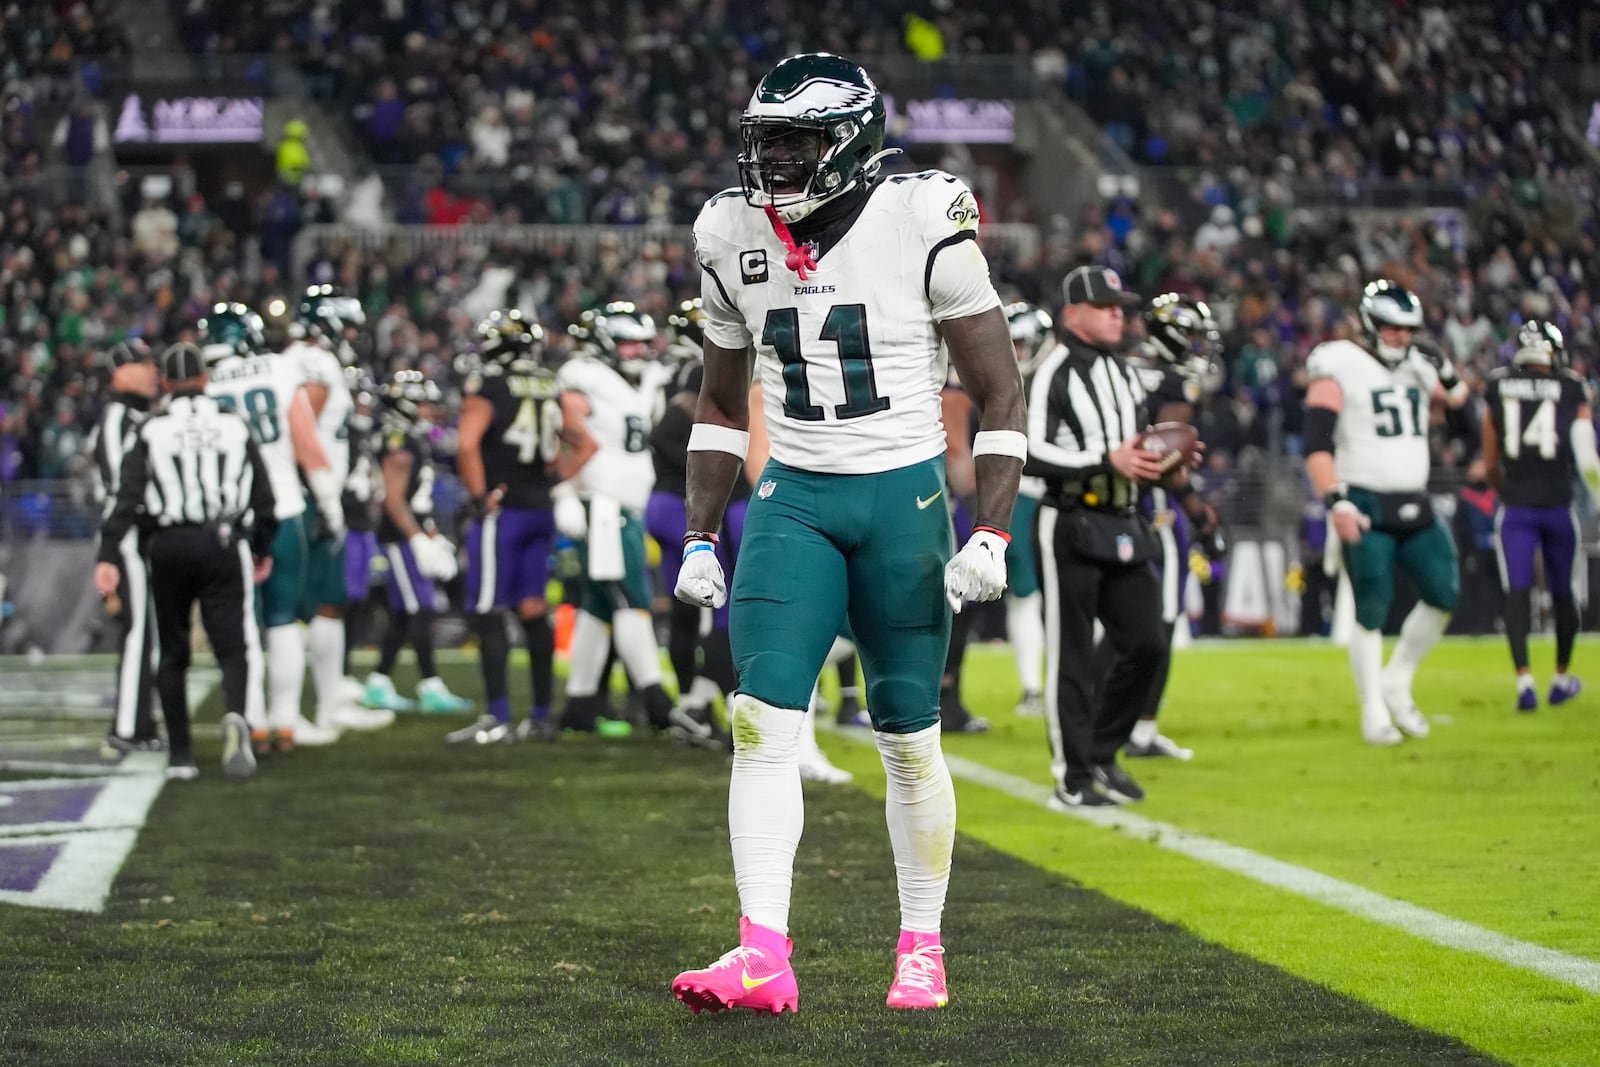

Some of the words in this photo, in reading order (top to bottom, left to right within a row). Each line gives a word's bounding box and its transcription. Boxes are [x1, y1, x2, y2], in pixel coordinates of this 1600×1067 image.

[742, 251, 766, 276] C
[794, 285, 836, 295] EAGLES
[762, 303, 891, 421] 11
[503, 398, 564, 464] 40
[1371, 386, 1423, 437] 51
[1502, 396, 1559, 459] 14
